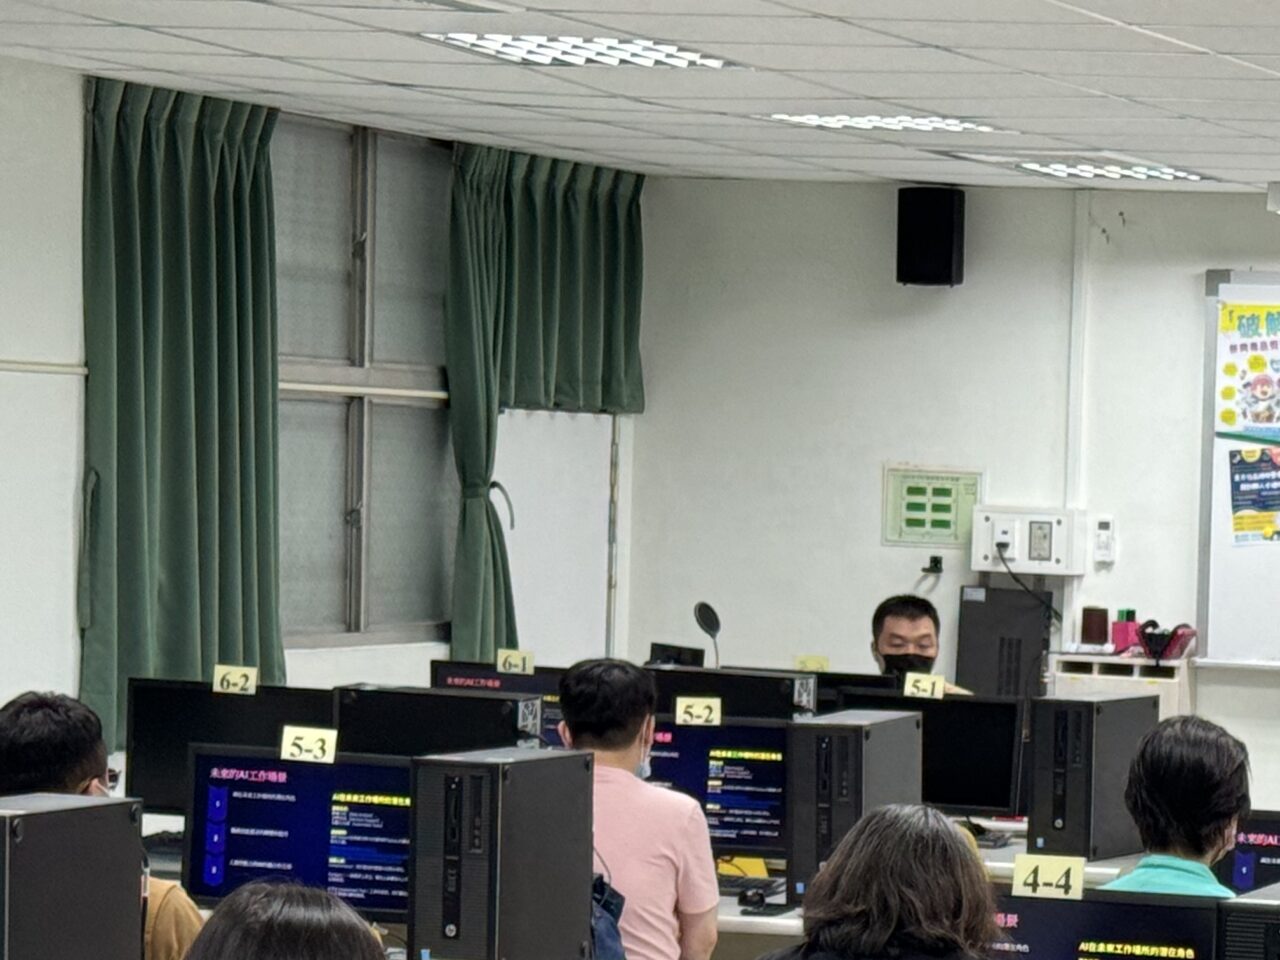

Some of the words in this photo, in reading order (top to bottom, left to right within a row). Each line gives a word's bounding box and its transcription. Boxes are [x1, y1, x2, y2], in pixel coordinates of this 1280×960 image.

[502, 655, 527, 672] 6-1
[220, 672, 250, 692] 6-2
[911, 680, 937, 697] 5-1
[683, 704, 714, 723] 5-2
[289, 736, 327, 760] 5-3
[1022, 864, 1073, 896] 4-4
